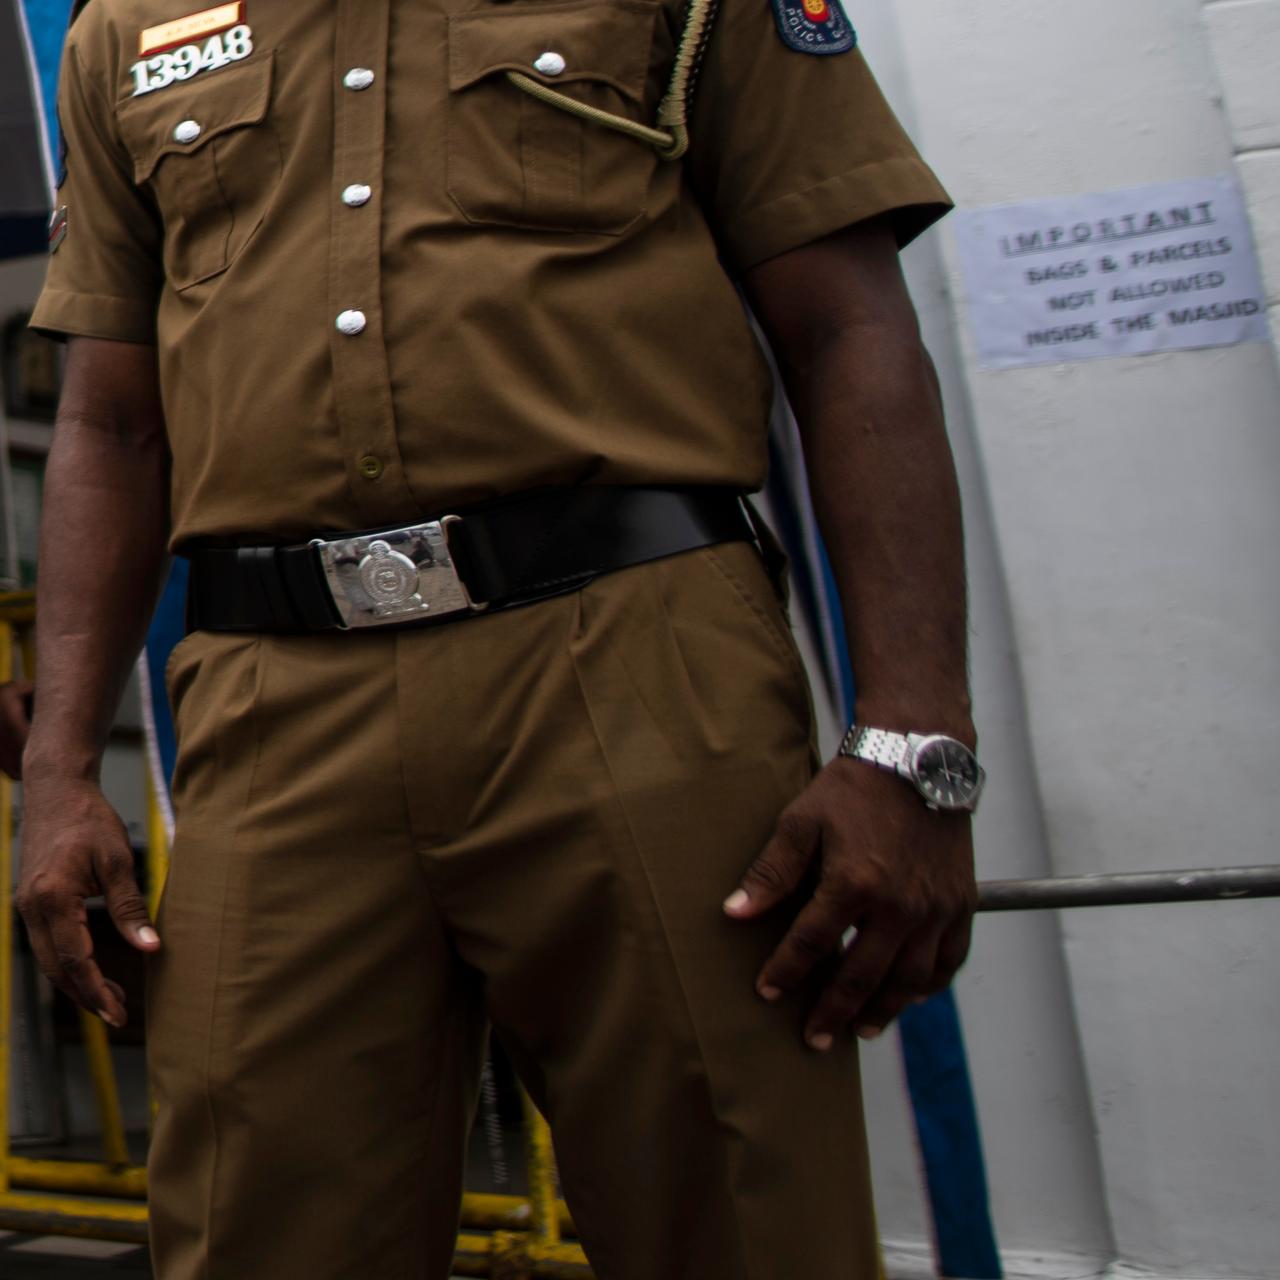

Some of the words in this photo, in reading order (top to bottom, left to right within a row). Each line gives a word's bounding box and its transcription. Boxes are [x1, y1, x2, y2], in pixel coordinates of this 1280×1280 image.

[786, 7, 826, 43] POLICE
[129, 24, 254, 98] 13948
[999, 200, 1217, 256] IMPORTANT
[1025, 258, 1088, 286] BAGS
[1098, 253, 1119, 274] &
[1130, 235, 1233, 269] PARCELS
[1046, 289, 1096, 313] NOT
[1109, 269, 1226, 303] ALLOWED
[1025, 320, 1101, 348] INSIDE
[1111, 312, 1157, 336] THE
